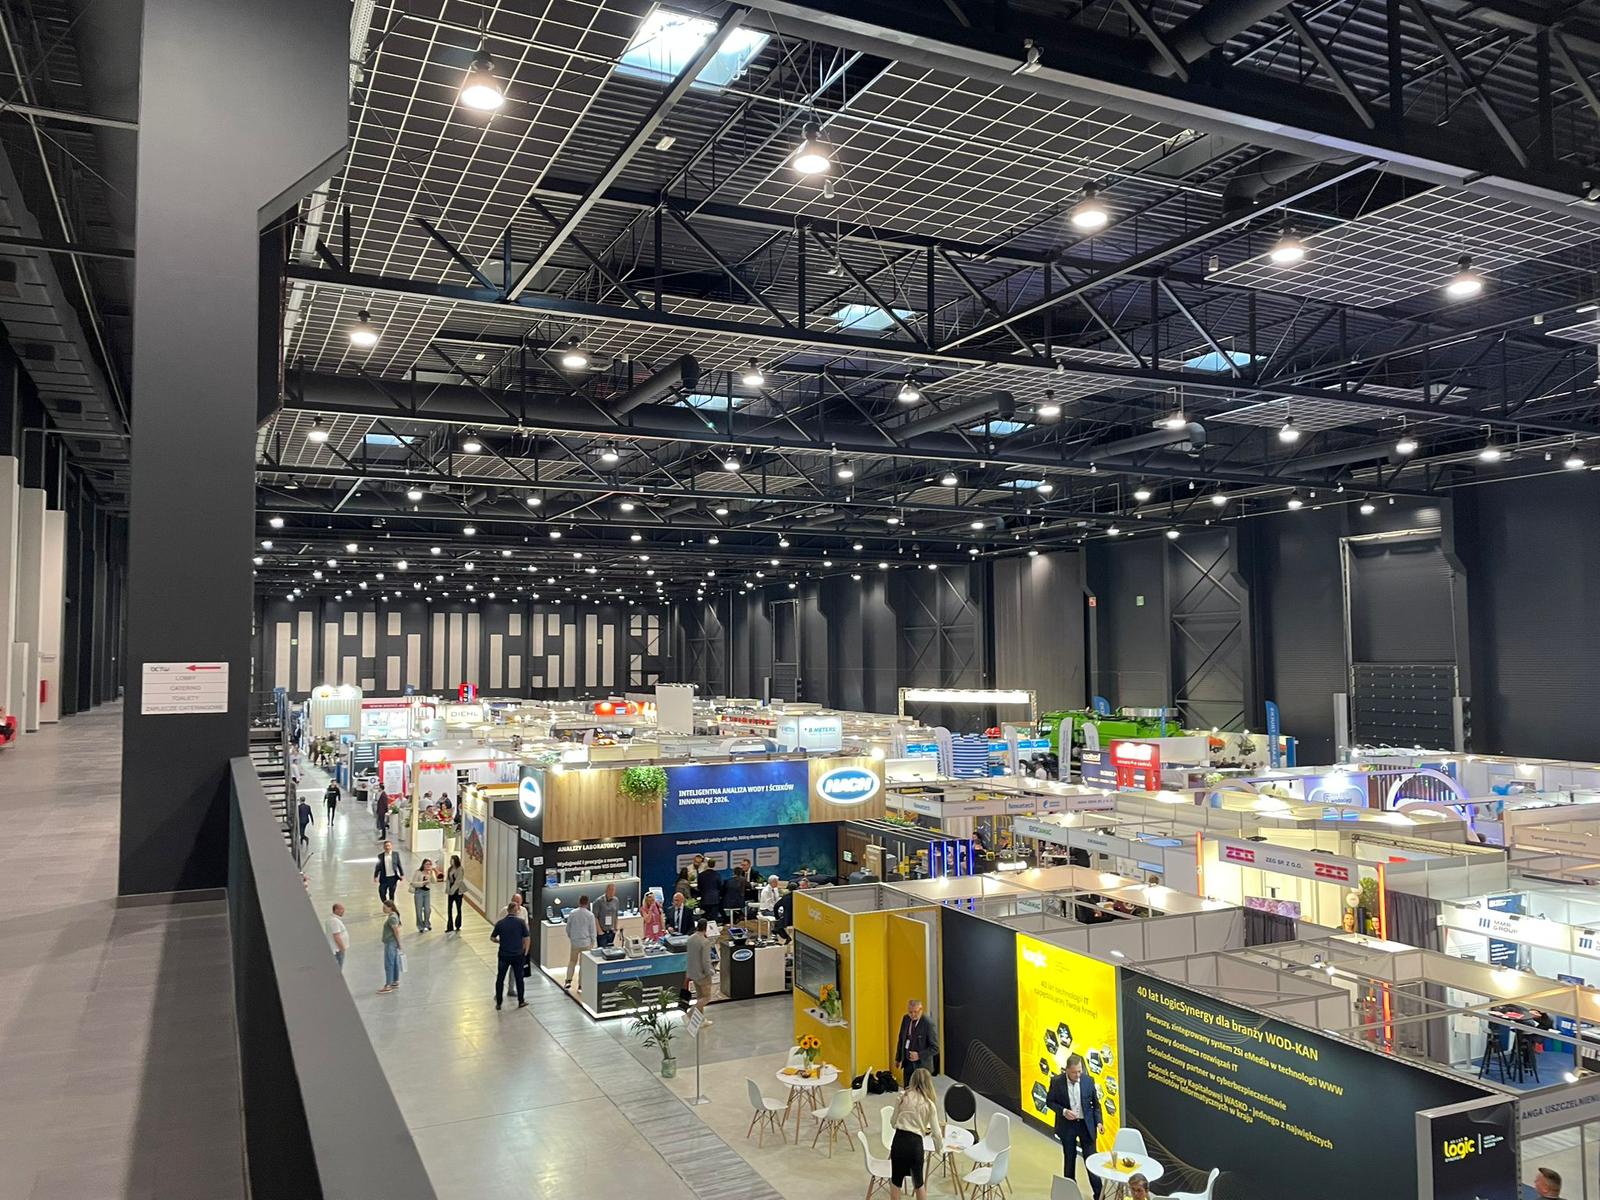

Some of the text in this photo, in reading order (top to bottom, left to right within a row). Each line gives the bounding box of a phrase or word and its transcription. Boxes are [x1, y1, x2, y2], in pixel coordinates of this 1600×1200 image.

[678, 789, 722, 797] INTELIGENTNA
[769, 782, 794, 792] ŚCIEKÓW
[678, 797, 714, 806] INNOWACJE
[1137, 986, 1318, 1061] 40 lat LogicSynergy dla branży WOD-KAN
[1146, 1029, 1238, 1072] Kluczowy dostawca rozwiązań IT
[1146, 1012, 1171, 1029] Pierwszy,
[1172, 1022, 1210, 1046] zintegrowany
[1211, 1040, 1232, 1052] system
[1244, 1052, 1270, 1067] eMedia
[1270, 1062, 1277, 1070] w
[1278, 1064, 1318, 1086] technologii
[1318, 1079, 1344, 1096] WWW
[1147, 1045, 1186, 1069] Doświadczony
[1186, 1063, 1209, 1077] partner
[1216, 1076, 1286, 1110] cyberbezpieczeństwie
[1148, 1062, 1170, 1076] Członek
[1170, 1071, 1188, 1086] Grupy
[1188, 1079, 1224, 1102] Kapitałowej
[1224, 1094, 1248, 1112] WASKO
[1286, 1124, 1334, 1150] największych
[1230, 1108, 1236, 1116] w
[1236, 1108, 1254, 1124] kraju
[1522, 1108, 1544, 1120] ANGA
[1444, 1136, 1476, 1159] logic
